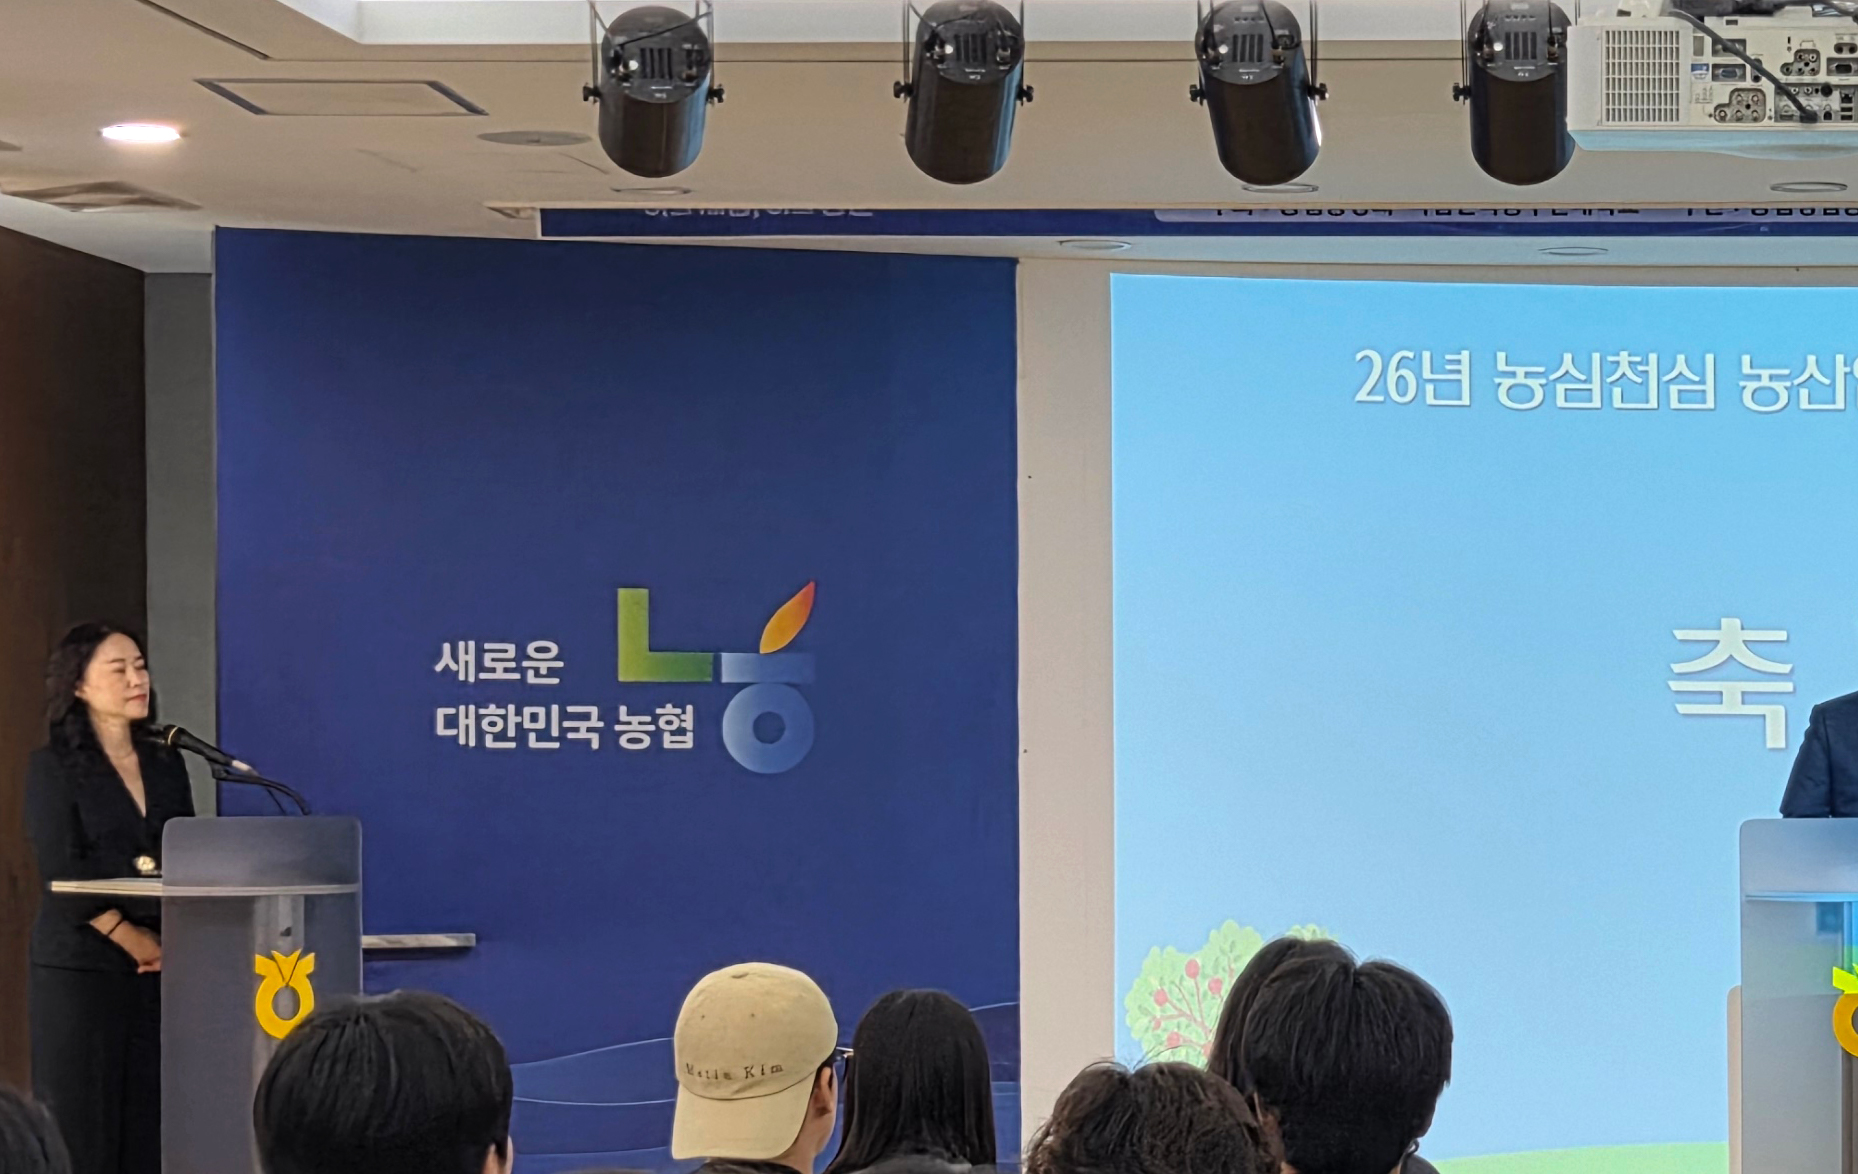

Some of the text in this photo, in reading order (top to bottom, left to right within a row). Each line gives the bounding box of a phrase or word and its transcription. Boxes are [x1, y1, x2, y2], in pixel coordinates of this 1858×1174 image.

[1354, 349, 1471, 406] 26년
[1493, 351, 1716, 411] 농심천심
[434, 639, 566, 686] 새로운
[435, 702, 696, 751] 대한민국 농협
